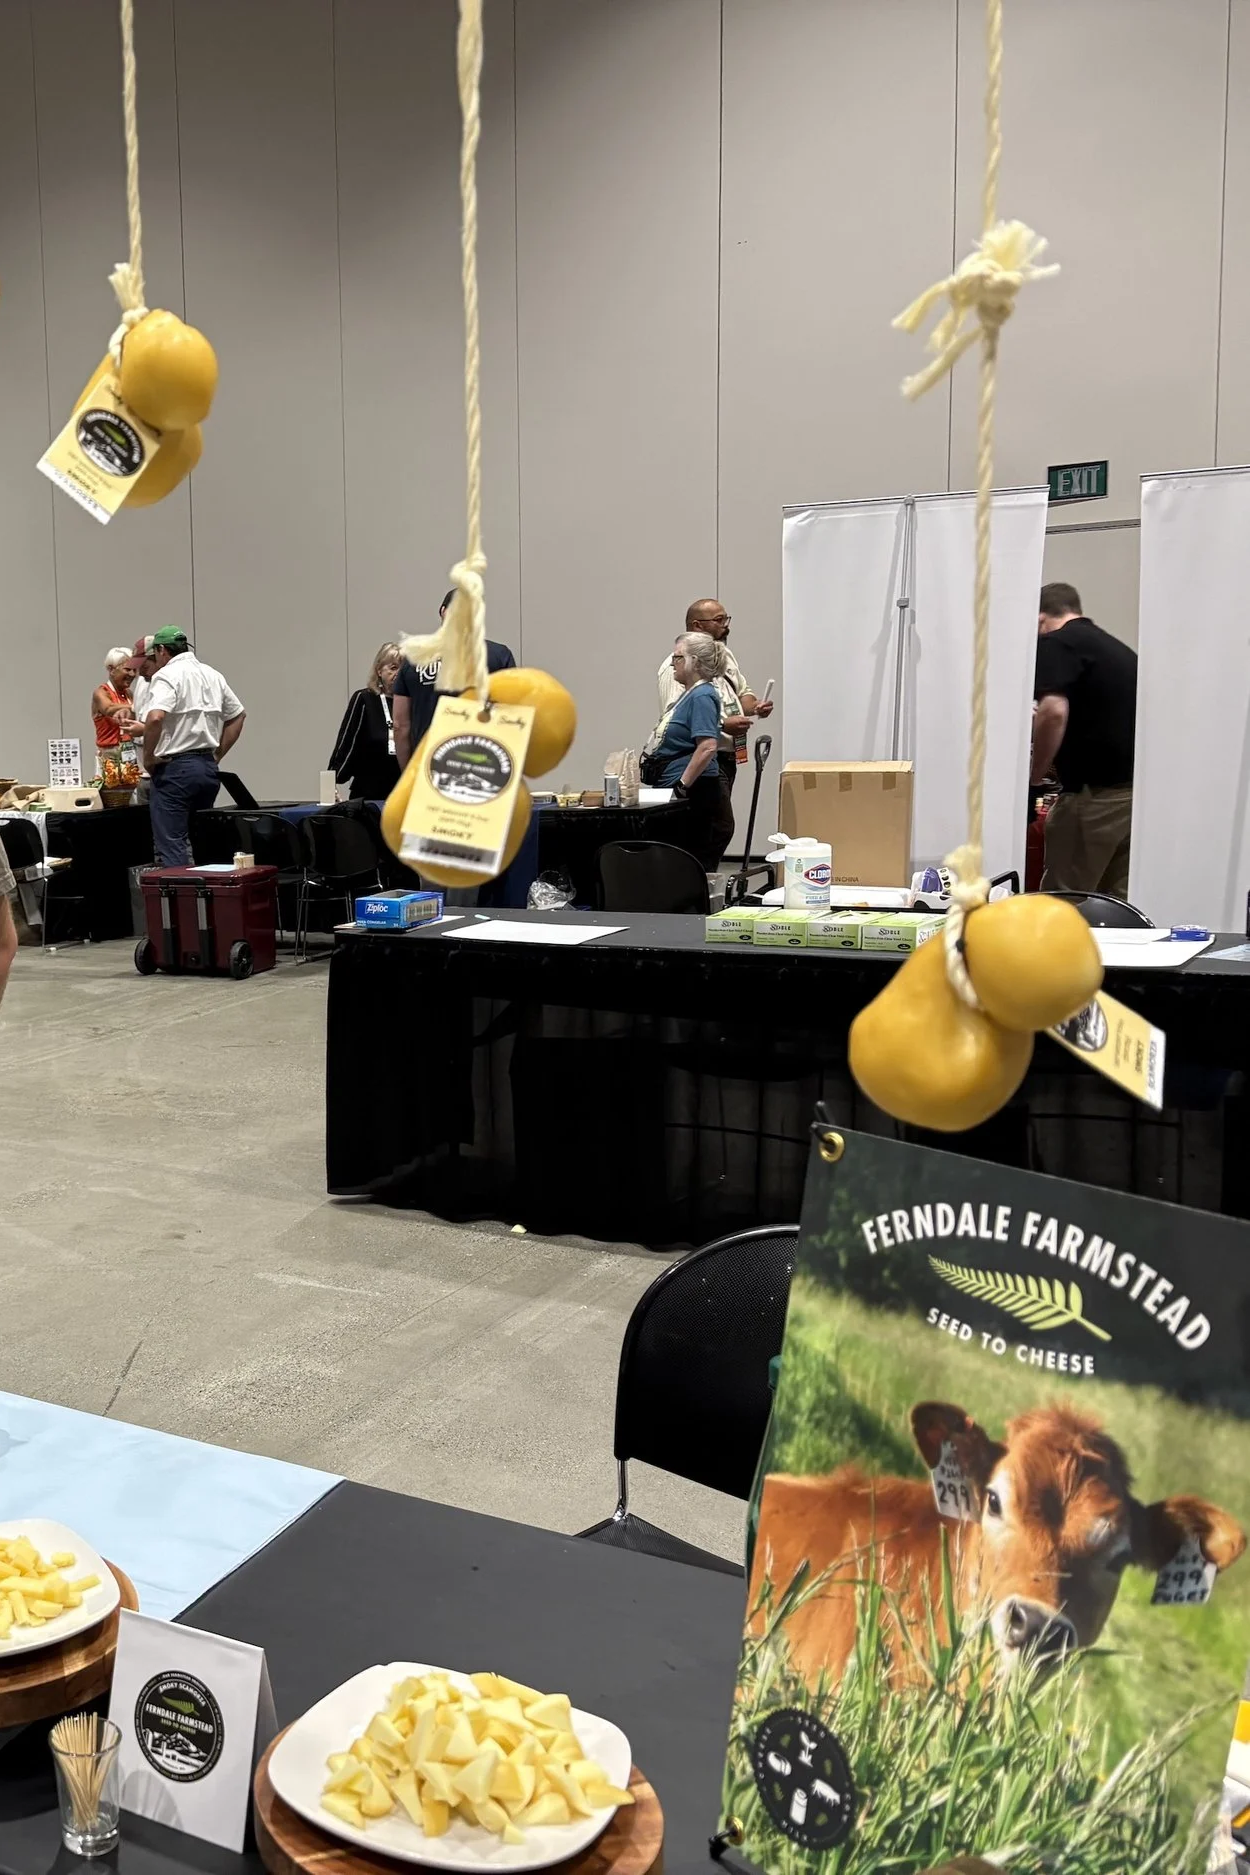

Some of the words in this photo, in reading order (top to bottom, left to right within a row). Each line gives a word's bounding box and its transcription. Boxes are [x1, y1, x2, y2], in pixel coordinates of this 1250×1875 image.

[1057, 465, 1101, 496] EXIT
[365, 902, 389, 914] Ziploc
[861, 1201, 1012, 1254] FERNDALE
[1020, 1209, 1212, 1352] FARMSTEAD
[925, 1306, 973, 1343] SEED
[981, 1332, 1008, 1357] TO
[1016, 1343, 1096, 1376] CHEESE
[937, 1479, 970, 1512] 299
[158, 1682, 178, 1693] SMOKY
[178, 1683, 207, 1707] SCAMORZA
[146, 1703, 177, 1721] FERNDALE
[177, 1712, 214, 1734] FARMSTEAD
